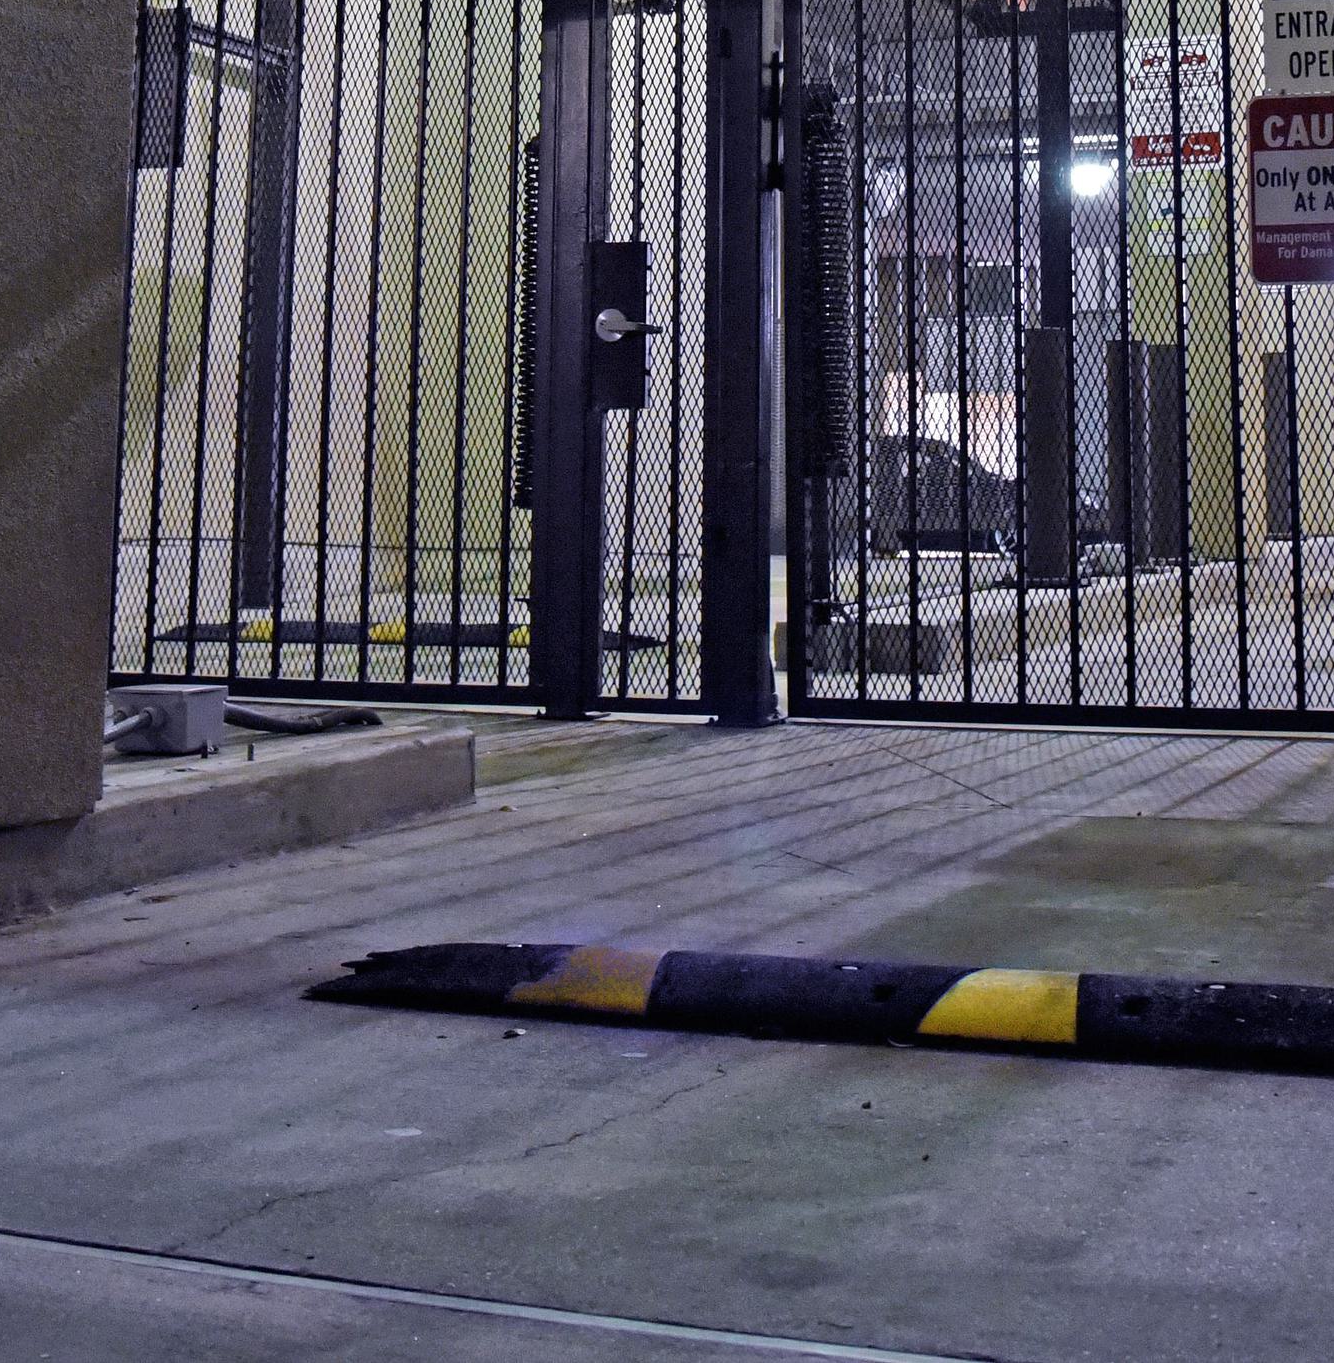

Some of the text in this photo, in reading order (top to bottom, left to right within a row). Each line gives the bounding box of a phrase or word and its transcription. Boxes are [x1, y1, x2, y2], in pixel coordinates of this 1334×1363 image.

[1255, 166, 1300, 192] Only
[1293, 191, 1317, 213] At
[1255, 228, 1332, 246] Management
[1277, 246, 1296, 260] For
